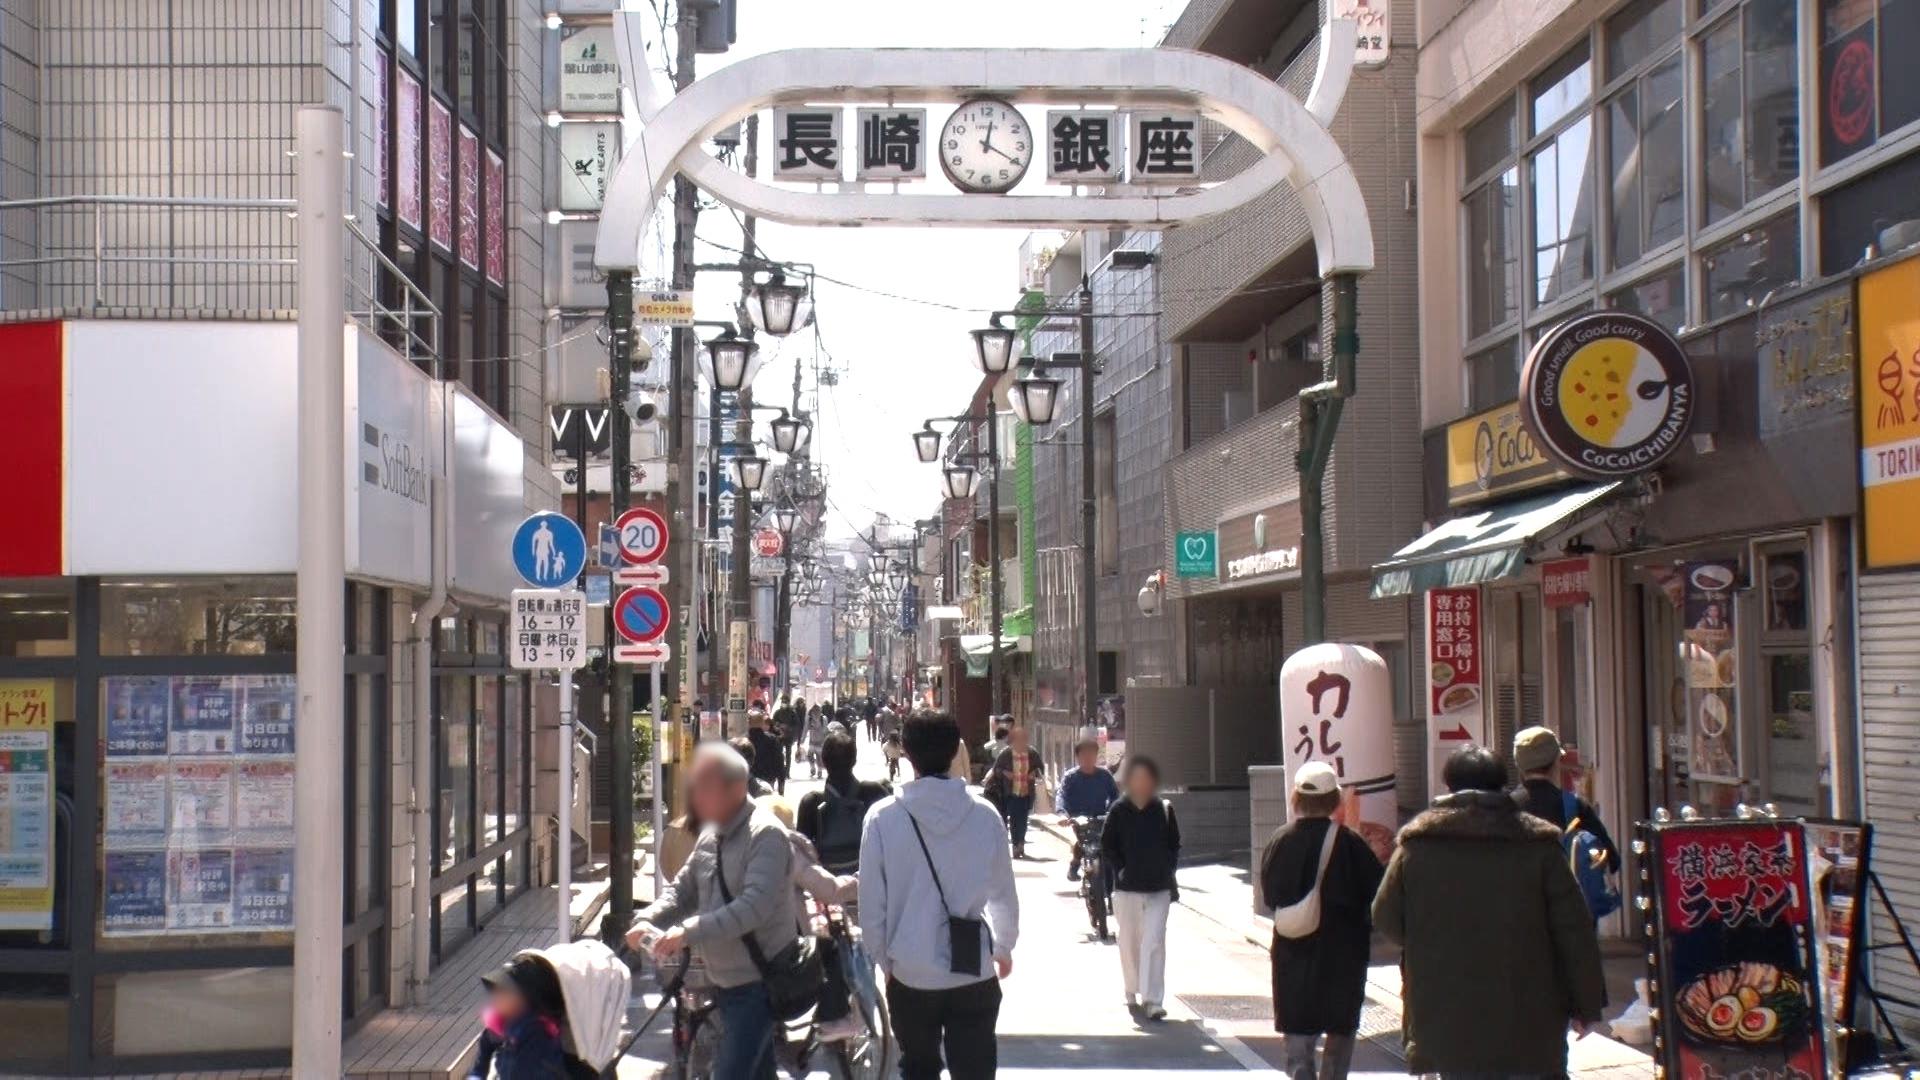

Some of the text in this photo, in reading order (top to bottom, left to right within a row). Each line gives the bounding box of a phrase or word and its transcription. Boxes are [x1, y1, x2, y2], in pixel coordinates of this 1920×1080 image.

[596, 131, 606, 172] HEARTS
[1542, 369, 1557, 406] Good
[1575, 322, 1609, 343] Good
[1611, 325, 1647, 341] curry
[381, 433, 427, 506] SoftBank
[625, 525, 656, 550] 20
[517, 599, 581, 613] 自転車は通行可
[1435, 594, 1453, 659] 専用窓口
[519, 633, 578, 647] 日曜・休日は
[1454, 594, 1473, 674] お持ち帰り
[1679, 877, 1796, 928] ラーメン
